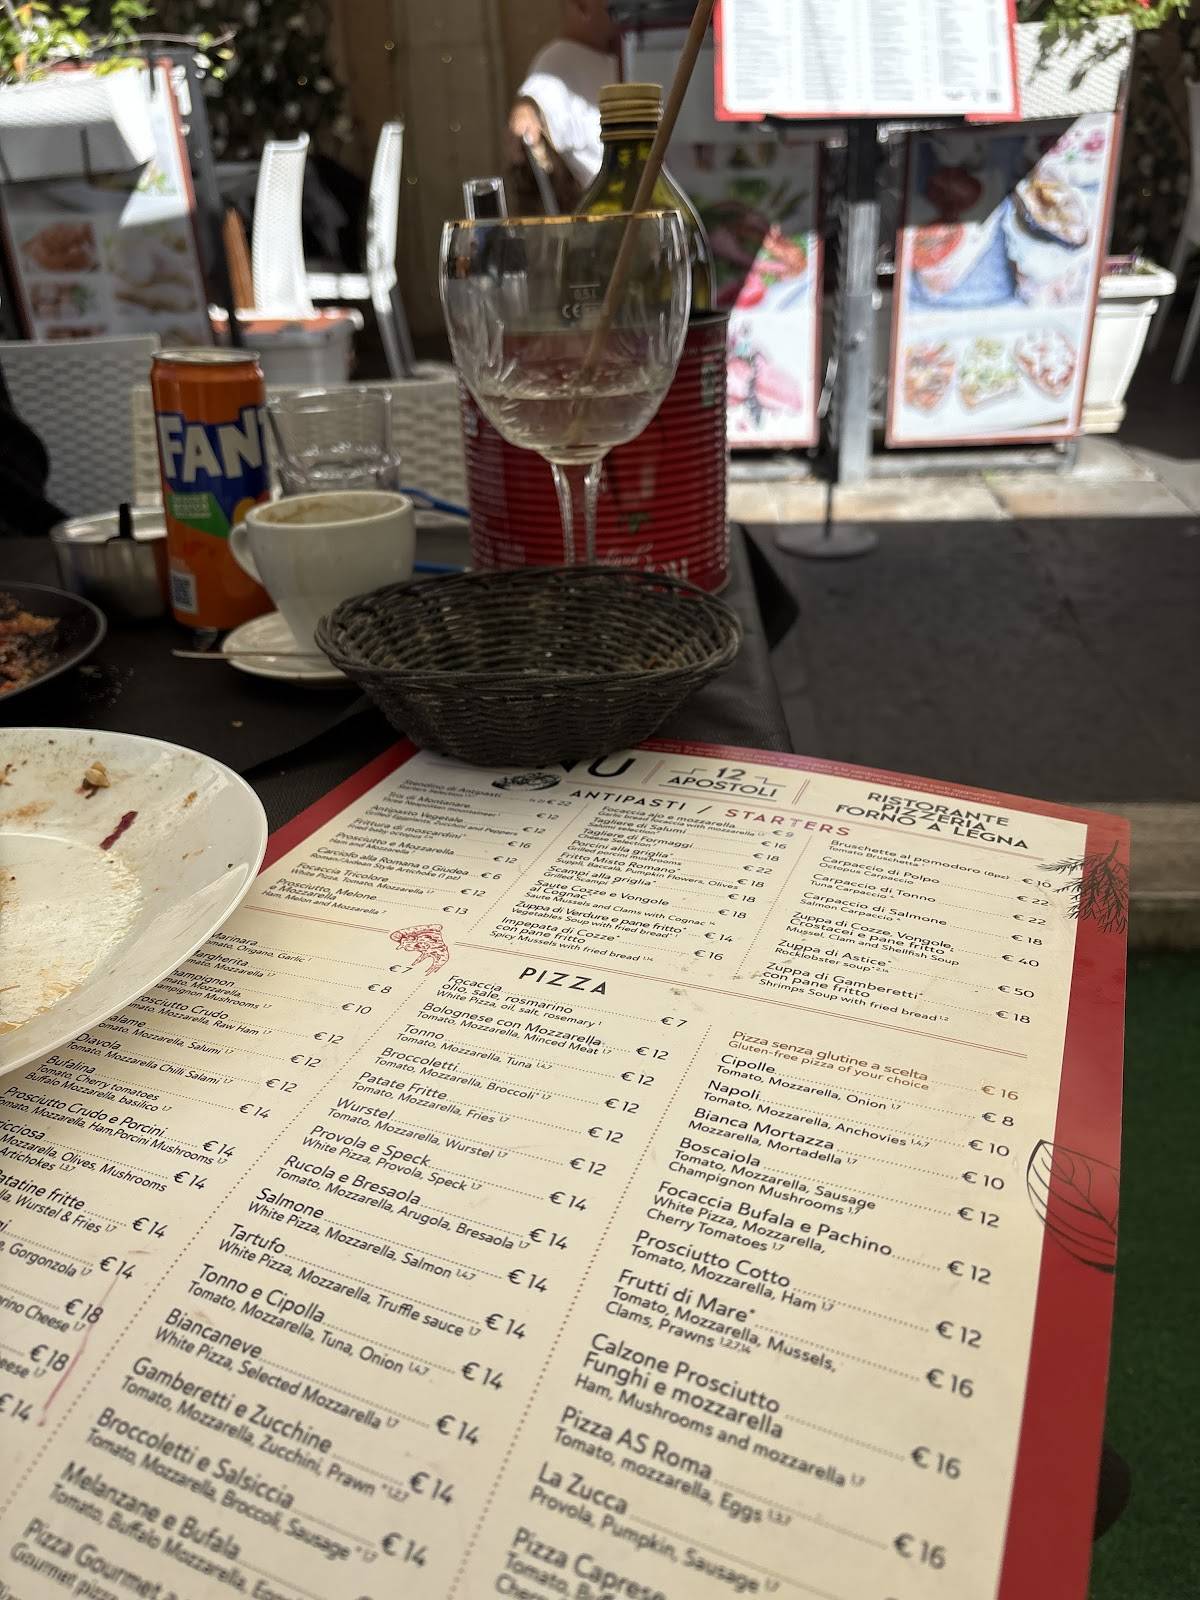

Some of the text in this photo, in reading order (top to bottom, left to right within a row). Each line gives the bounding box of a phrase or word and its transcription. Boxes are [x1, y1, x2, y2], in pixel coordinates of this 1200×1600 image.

[667, 775, 779, 798] APOSTOLI
[716, 766, 746, 781] 12
[569, 790, 687, 811] ANTIPASTI
[724, 808, 851, 837] STARTERS
[867, 791, 1009, 828] RISTORANTE
[882, 803, 986, 831] PIZZERIA
[836, 804, 1029, 850] FORNO A LEGNA
[822, 854, 883, 872] Carpaccio
[903, 870, 939, 883] Polpo
[535, 879, 567, 889] Saute
[570, 885, 606, 895] Cozze
[620, 893, 668, 905] Vongole
[803, 891, 868, 909] Carpaccio
[889, 908, 946, 925] Salmone
[793, 911, 831, 924] Zuppa
[490, 930, 515, 940] Spicy
[517, 935, 557, 946] Mussels
[582, 946, 607, 954] fried
[609, 950, 640, 960] bread
[519, 929, 550, 937] pane
[553, 932, 585, 943] fritto
[789, 917, 853, 935] Crostacei
[869, 935, 904, 946] pane
[909, 941, 944, 954] fritto
[448, 975, 504, 992] Focaccia
[518, 966, 607, 995] PIZZA
[505, 996, 573, 1013] rosmarino
[759, 978, 936, 1020] Shrimps Soup with fried bread
[405, 1024, 444, 1039] Tonno
[423, 1002, 601, 1045] Bolognese con Mozzarella
[44, 1055, 95, 1073] Bufalina
[381, 1047, 461, 1071] Broccoletti
[720, 1054, 776, 1073] Cipolle
[728, 1039, 798, 1061] Gluten-free
[801, 1057, 834, 1069] pizza
[854, 1069, 883, 1079] your
[886, 1075, 928, 1089] choice
[733, 1030, 768, 1045] Pizza
[771, 1041, 813, 1055] senza
[816, 1050, 867, 1067] glutine
[883, 1066, 927, 1080] scelta
[359, 1071, 447, 1099] Patate Fritte
[708, 1078, 759, 1100] Napoli
[846, 1093, 885, 1109] Onion
[335, 1097, 396, 1120] Wurstel
[694, 1107, 833, 1149] Bianca Mortazza
[301, 1135, 467, 1190] White Pizza, Provola, Speck
[310, 1124, 433, 1167] Provola e Speck
[679, 1137, 760, 1166] Boscaiola
[99, 1163, 166, 1191] Mushrooms
[284, 1155, 420, 1204] Rucola e Bresaola
[668, 1160, 843, 1214] Champignon Mushrooms
[256, 1187, 323, 1218] Salmone
[658, 1179, 891, 1255] Focaccia Bufala e Pachino
[230, 1225, 285, 1253] Tartufo
[646, 1207, 767, 1251] Cherry Tomatoes
[636, 1228, 790, 1287] Prosciutto Cotto
[200, 1264, 324, 1323] Tonno e Cipolla
[218, 1237, 256, 1261] White
[377, 1295, 420, 1320] Truffle
[422, 1315, 463, 1336] sauce
[619, 1267, 691, 1304] Frutti di
[165, 1308, 262, 1358] Biancaneve
[591, 1330, 780, 1413] Calzone Prosciutto
[561, 1405, 712, 1480] Pizza AS Roma
[538, 1463, 627, 1514] La Zucca
